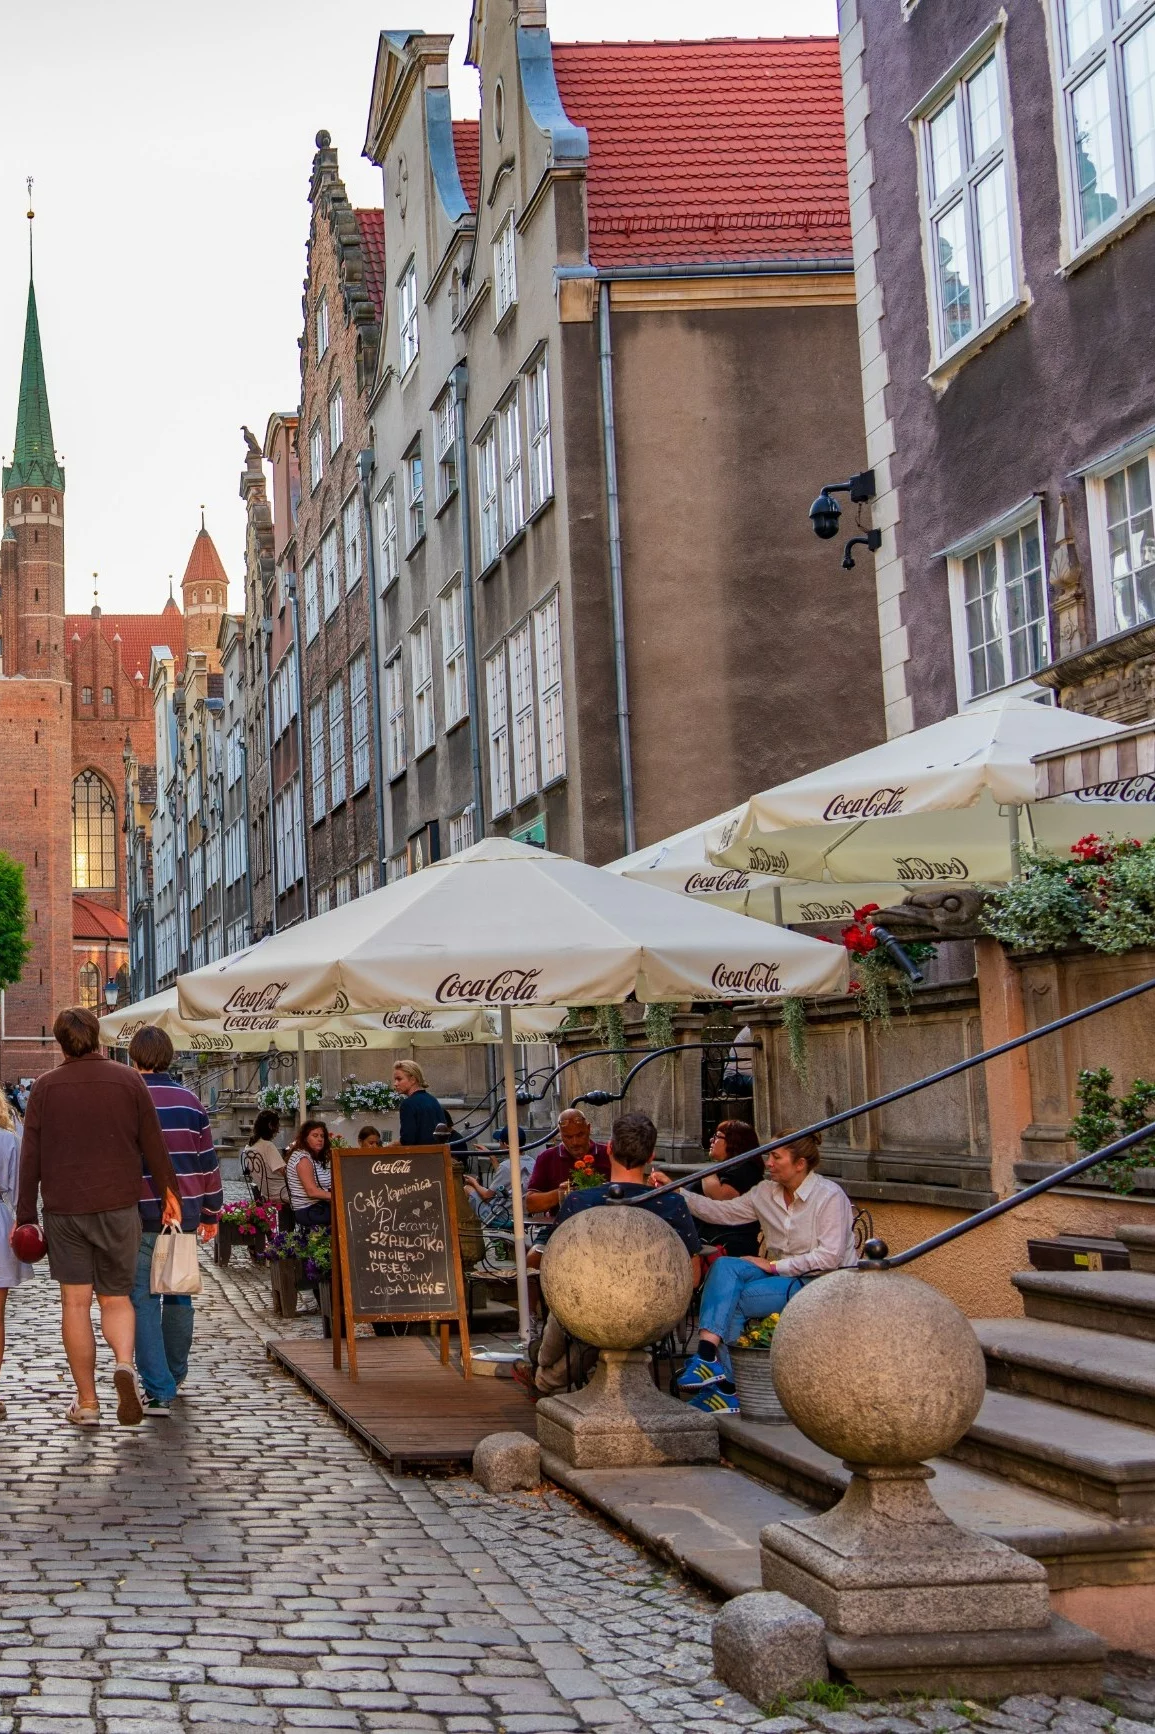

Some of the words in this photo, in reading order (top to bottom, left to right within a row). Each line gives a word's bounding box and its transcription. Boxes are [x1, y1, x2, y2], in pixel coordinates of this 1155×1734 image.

[823, 786, 909, 821] Coca-Cola
[684, 869, 750, 893] Coca-Cola
[436, 968, 544, 1004] Coca-Cola
[711, 963, 782, 993] Coca-Cola
[383, 1010, 435, 1029] Coca-Cola
[371, 1160, 412, 1174] Coca-Cola
[376, 1207, 438, 1238] Polecamy
[370, 1262, 411, 1274] DESER
[408, 1282, 446, 1295] LIBRE
